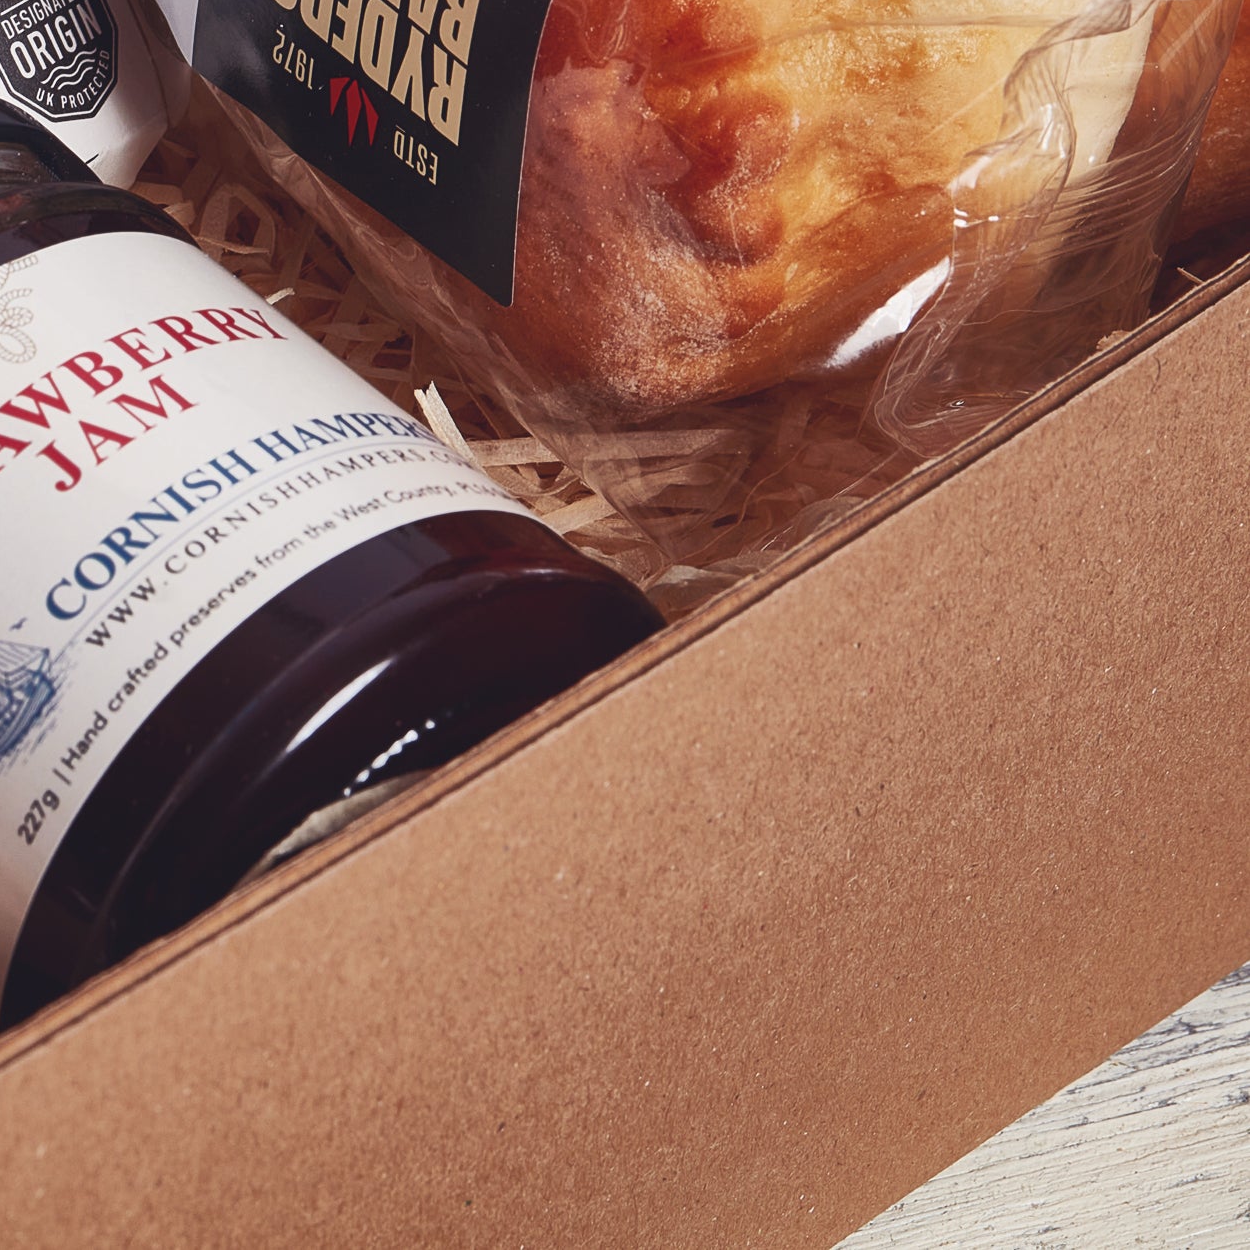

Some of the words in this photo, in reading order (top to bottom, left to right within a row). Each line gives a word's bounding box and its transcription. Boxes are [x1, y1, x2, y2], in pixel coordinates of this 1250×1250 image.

[9, 0, 103, 80] ORIGIN
[35, 87, 55, 108] UK
[60, 50, 111, 110] PROTECTED
[271, 28, 316, 91] 1972
[392, 124, 440, 186] ESTD
[35, 373, 200, 493] JAM
[45, 448, 258, 623] CORNISH
[17, 788, 61, 847] 227g
[60, 709, 109, 771] Hand
[107, 640, 170, 714] crafted
[169, 567, 259, 648] preserves
[254, 536, 303, 571] from
[302, 518, 340, 540] the
[335, 497, 381, 521] West
